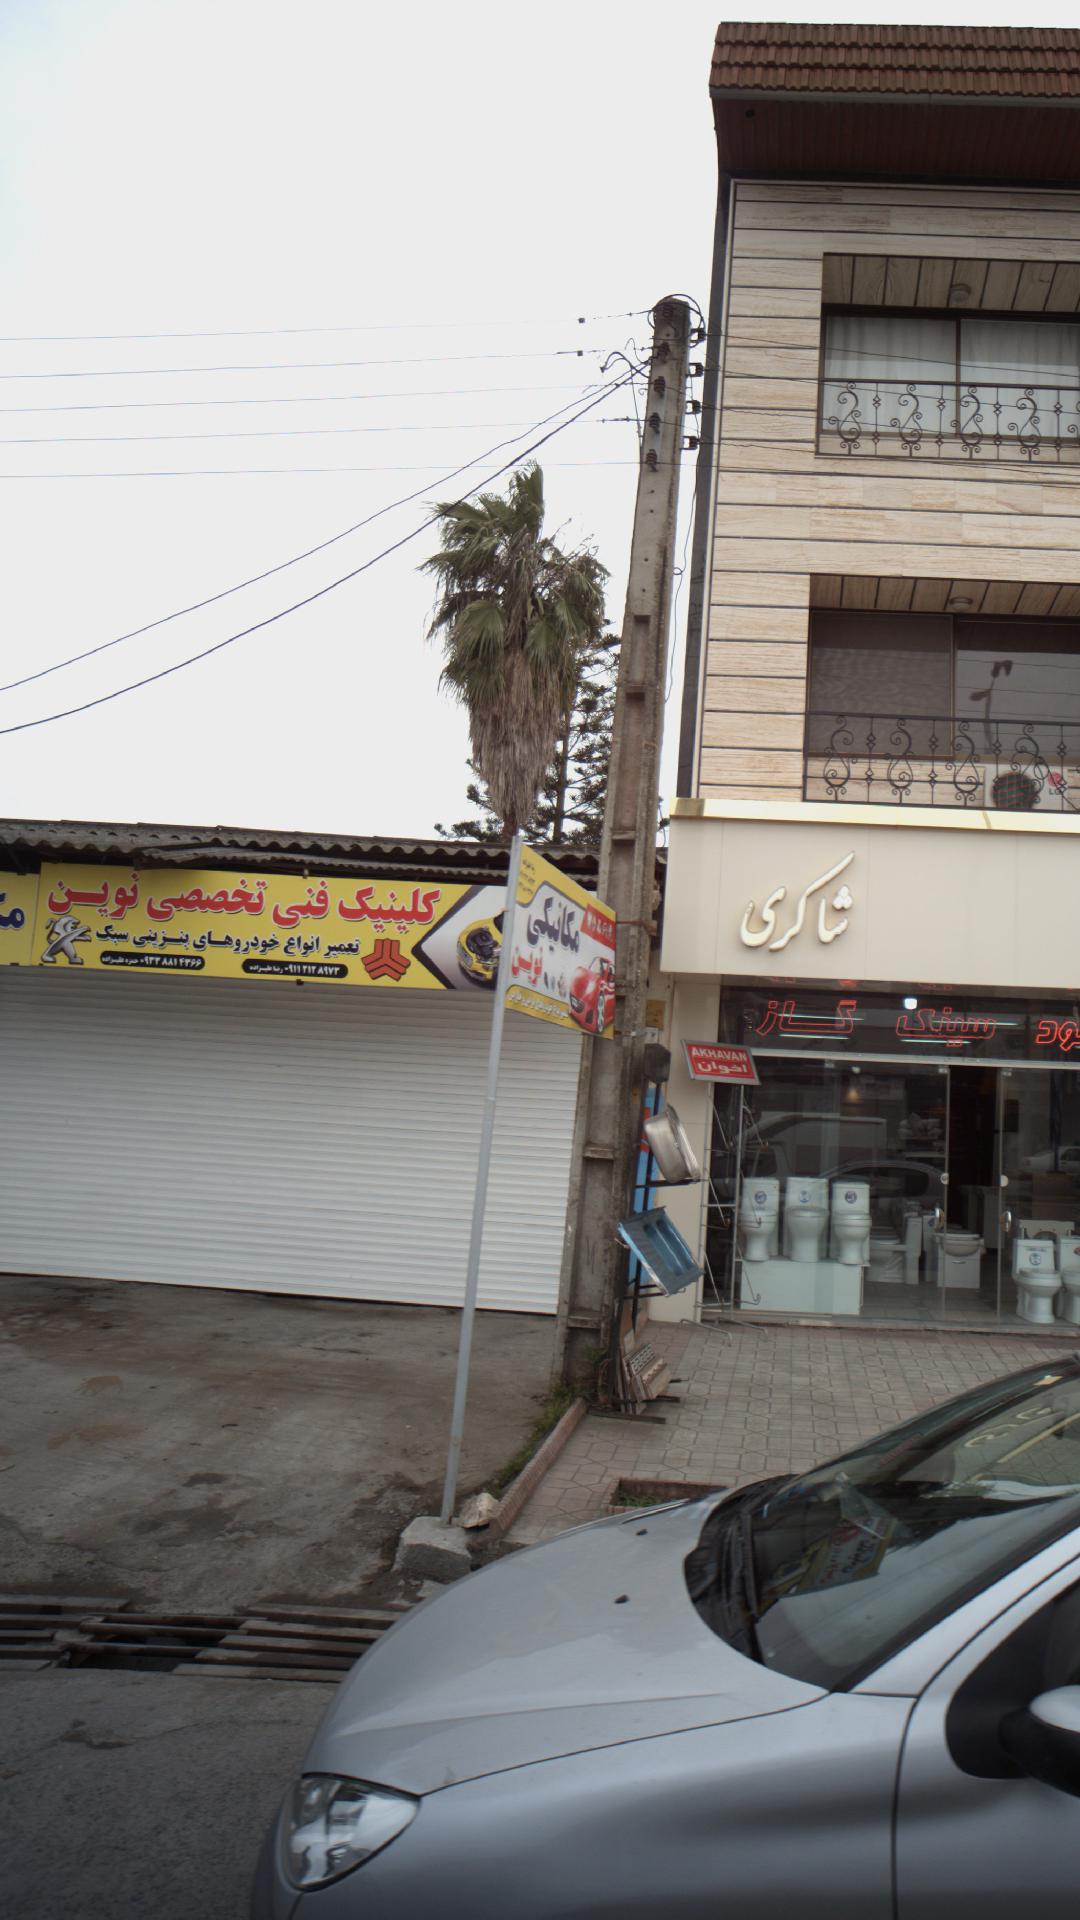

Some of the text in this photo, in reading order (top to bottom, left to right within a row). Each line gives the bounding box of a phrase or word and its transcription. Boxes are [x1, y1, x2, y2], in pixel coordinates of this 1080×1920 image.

[48, 871, 140, 919] نوین
[147, 879, 267, 920] تخصصی
[273, 881, 331, 927] فنی
[338, 887, 441, 932] کلینیک
[740, 850, 855, 952] شاکری
[95, 924, 361, 958] تعمیر انواع خودروهای بنزینی سبک
[526, 897, 580, 953] مکانیکی
[755, 1000, 858, 1036] گاز
[896, 1006, 996, 1047] سینک
[691, 1046, 748, 1062] AKHAVAN
[697, 1061, 748, 1074] اخوان
